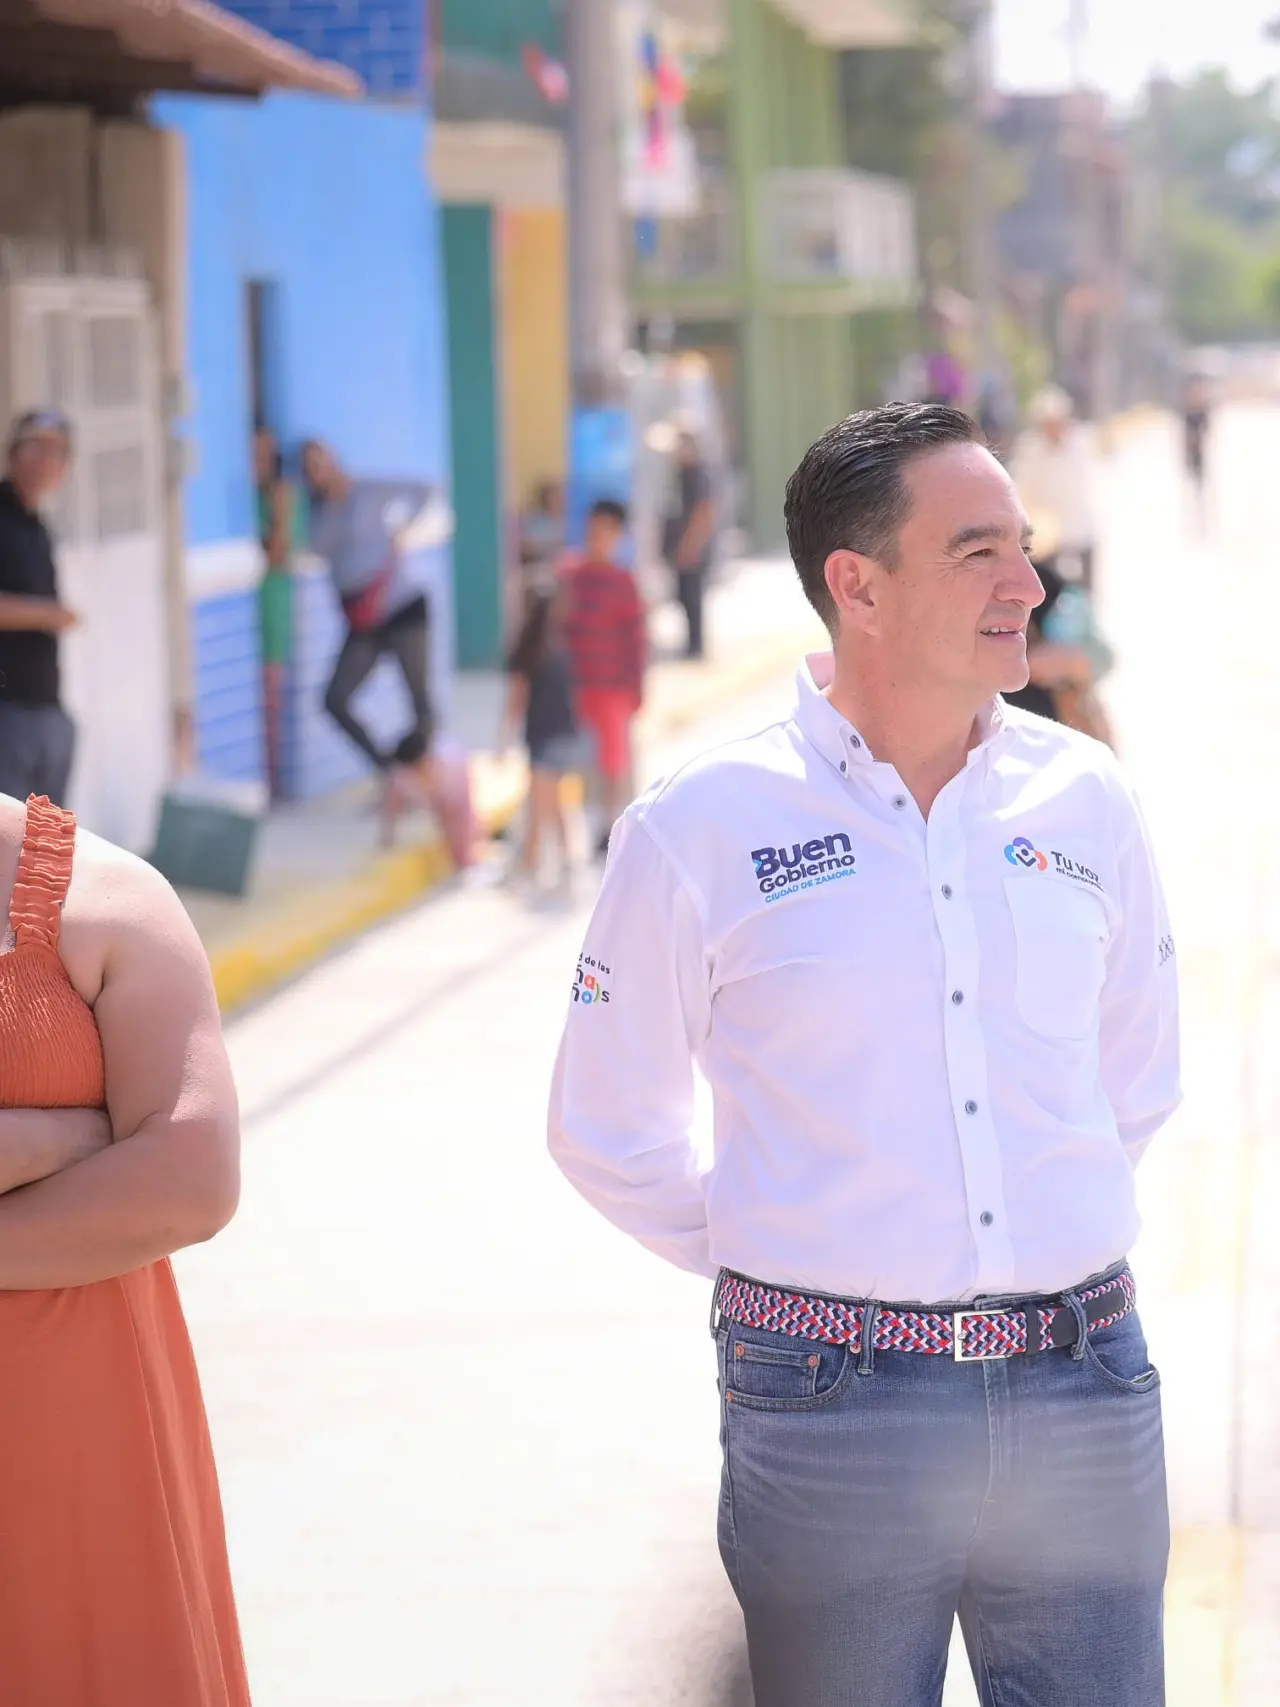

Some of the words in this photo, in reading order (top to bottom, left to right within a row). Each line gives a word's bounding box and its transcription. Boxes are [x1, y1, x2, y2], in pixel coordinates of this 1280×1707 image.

[751, 832, 852, 879] Buen
[1050, 850, 1073, 872] Tu
[759, 854, 855, 893] Gobierno
[765, 884, 799, 903] CIUDAD
[801, 879, 813, 889] DE
[815, 868, 856, 886] ZAMORA
[584, 955, 596, 967] de
[597, 959, 610, 974] las
